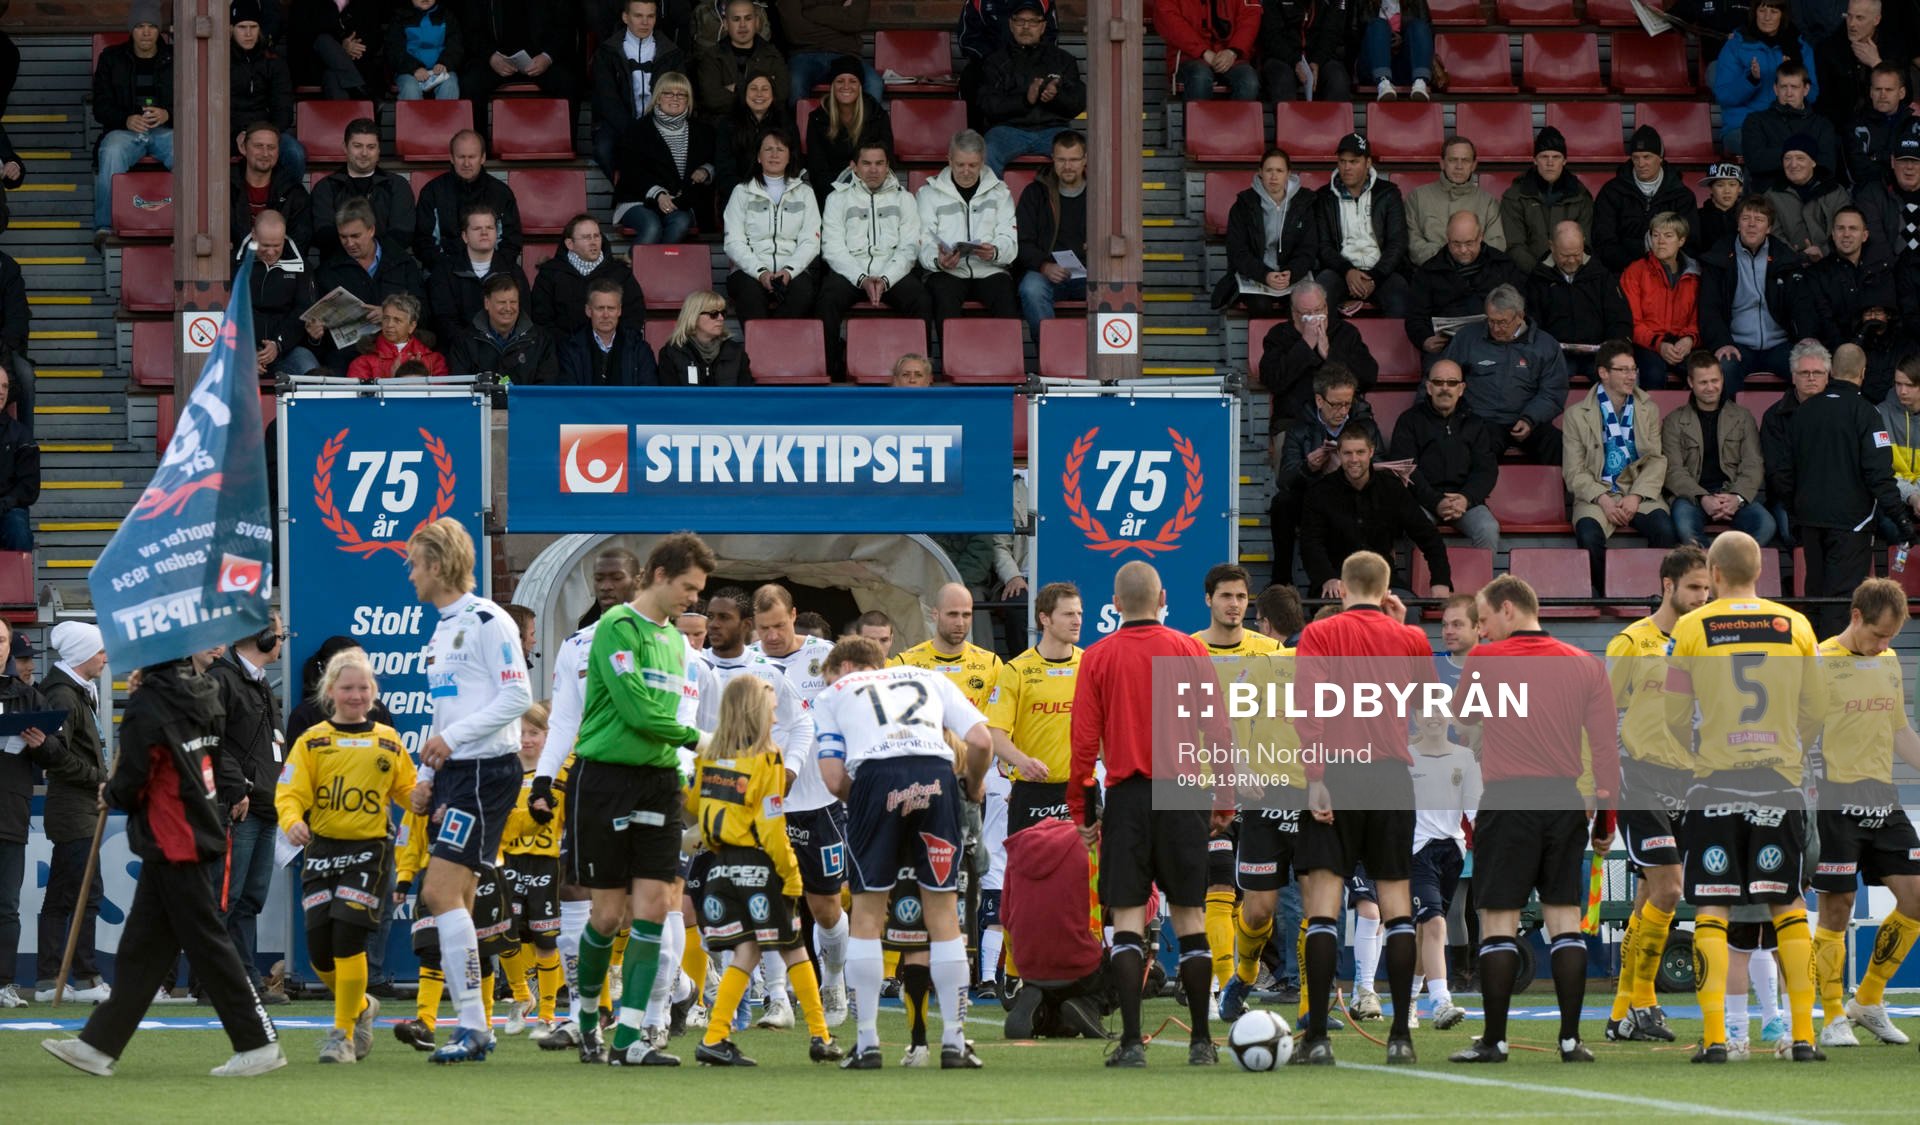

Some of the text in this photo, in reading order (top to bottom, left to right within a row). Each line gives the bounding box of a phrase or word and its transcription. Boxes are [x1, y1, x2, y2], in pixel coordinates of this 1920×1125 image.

[645, 434, 953, 484] STRYKTIPSET
[347, 450, 424, 513] 75
[1096, 450, 1172, 512] 75
[371, 513, 399, 537] år
[1119, 512, 1147, 536] år
[350, 605, 424, 635] Stolt
[1709, 618, 1771, 631] Swedbank
[854, 680, 936, 728] 12
[1730, 651, 1769, 725] 5
[316, 776, 381, 814] ellos
[1703, 801, 1787, 819] COOPER
[1413, 896, 1421, 909] 9
